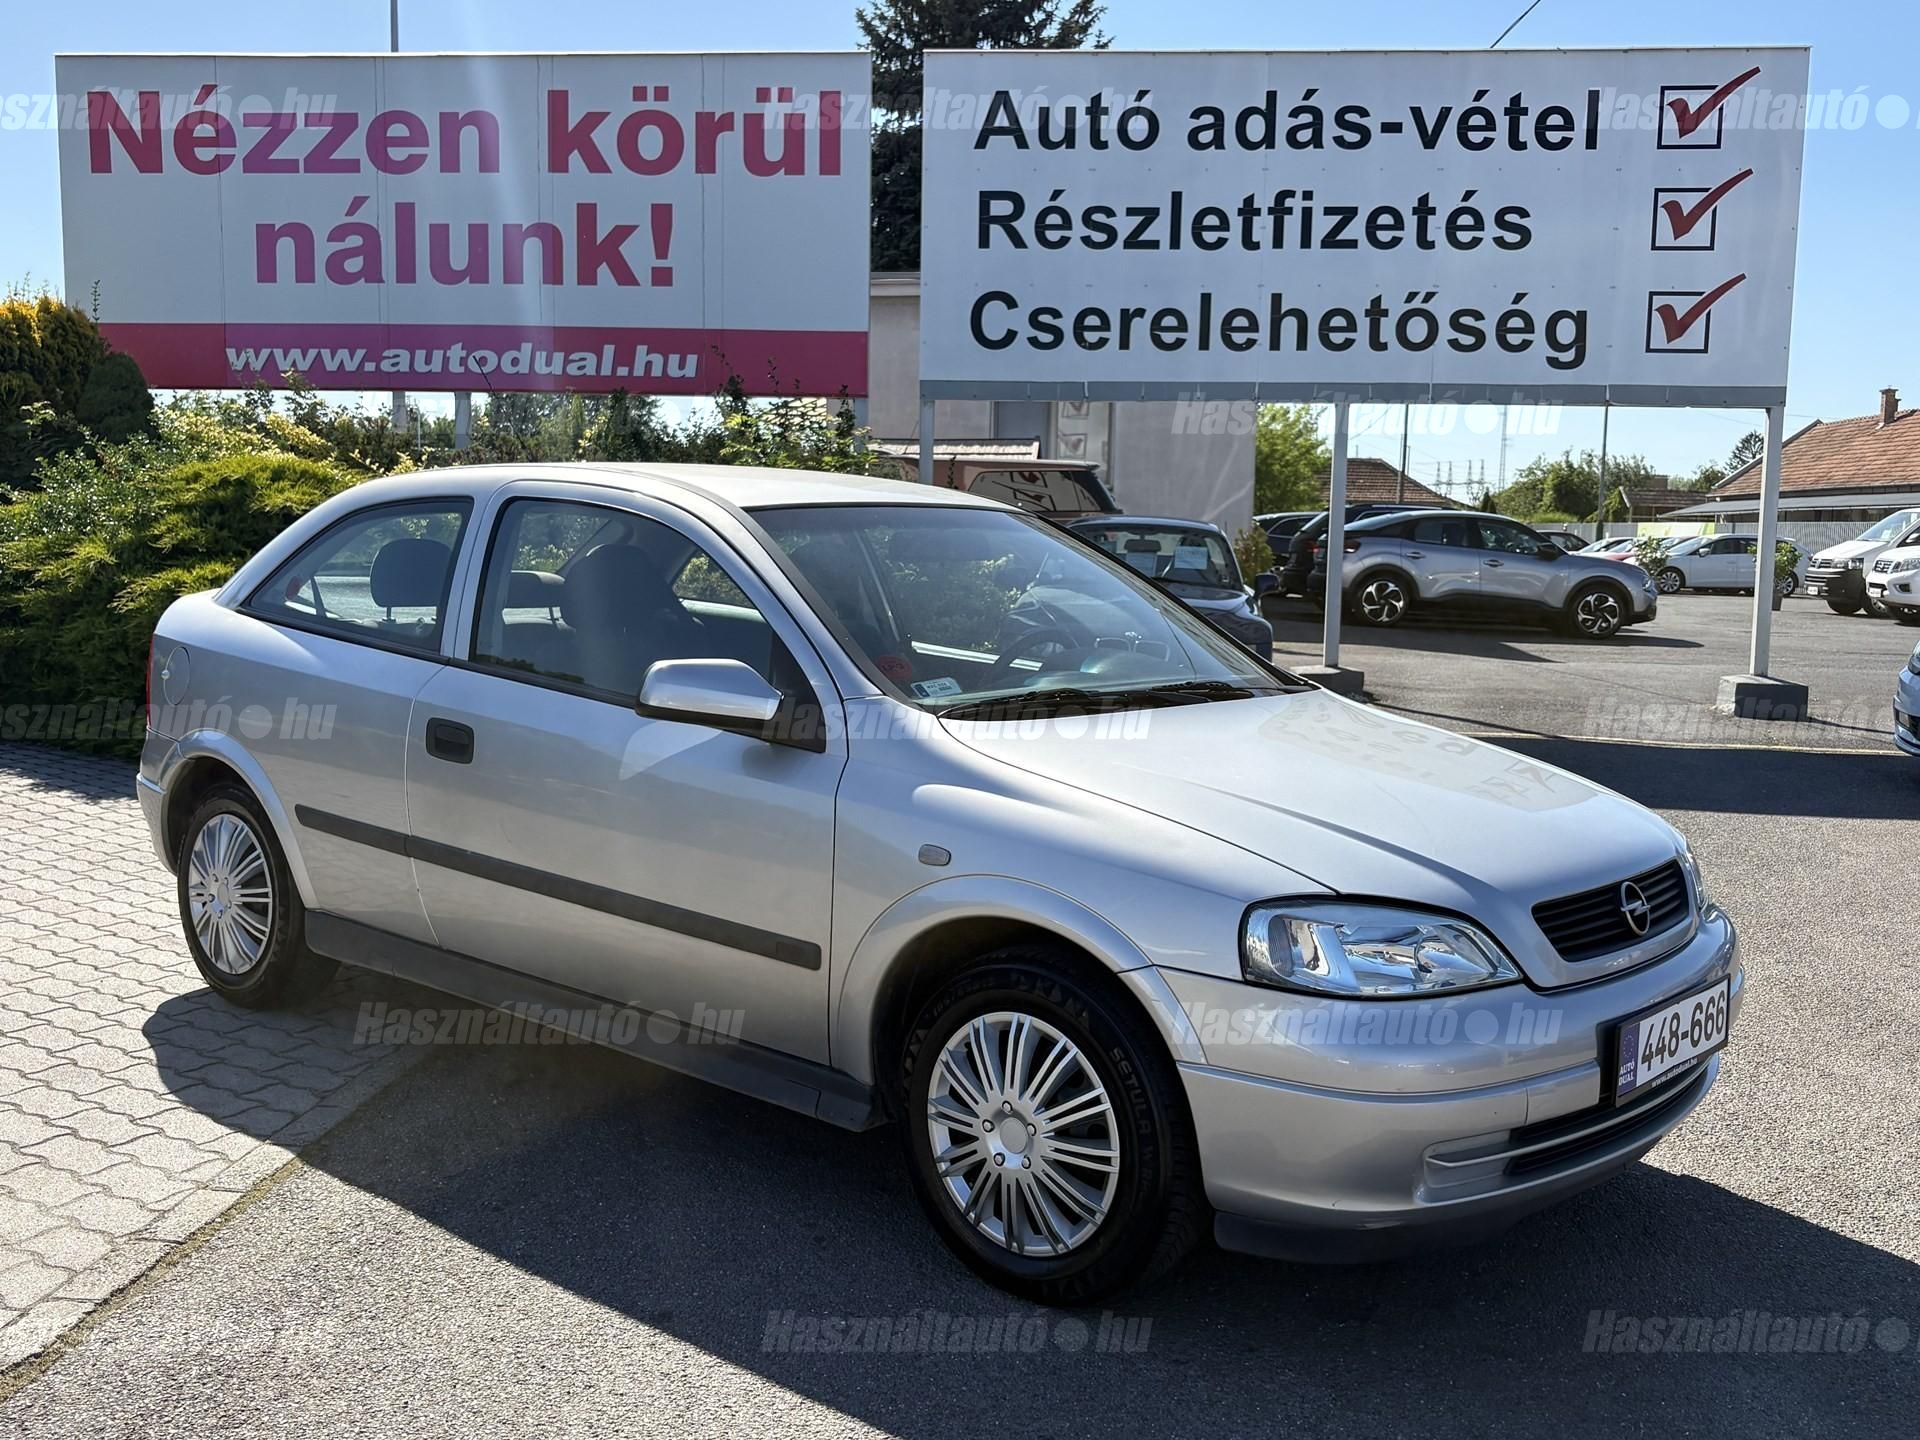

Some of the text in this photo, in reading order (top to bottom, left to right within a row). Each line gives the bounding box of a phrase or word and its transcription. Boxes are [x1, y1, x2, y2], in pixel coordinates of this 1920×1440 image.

[88, 84, 842, 176] Nézzen körül
[974, 88, 1601, 153] Autó adás-vétel
[255, 196, 675, 287] nálunk!
[976, 188, 1534, 253] Részletfizetés
[225, 342, 700, 380] www.autodual.hu
[969, 290, 1589, 372] Cserelehetőség
[1641, 990, 1725, 1072] 448-666
